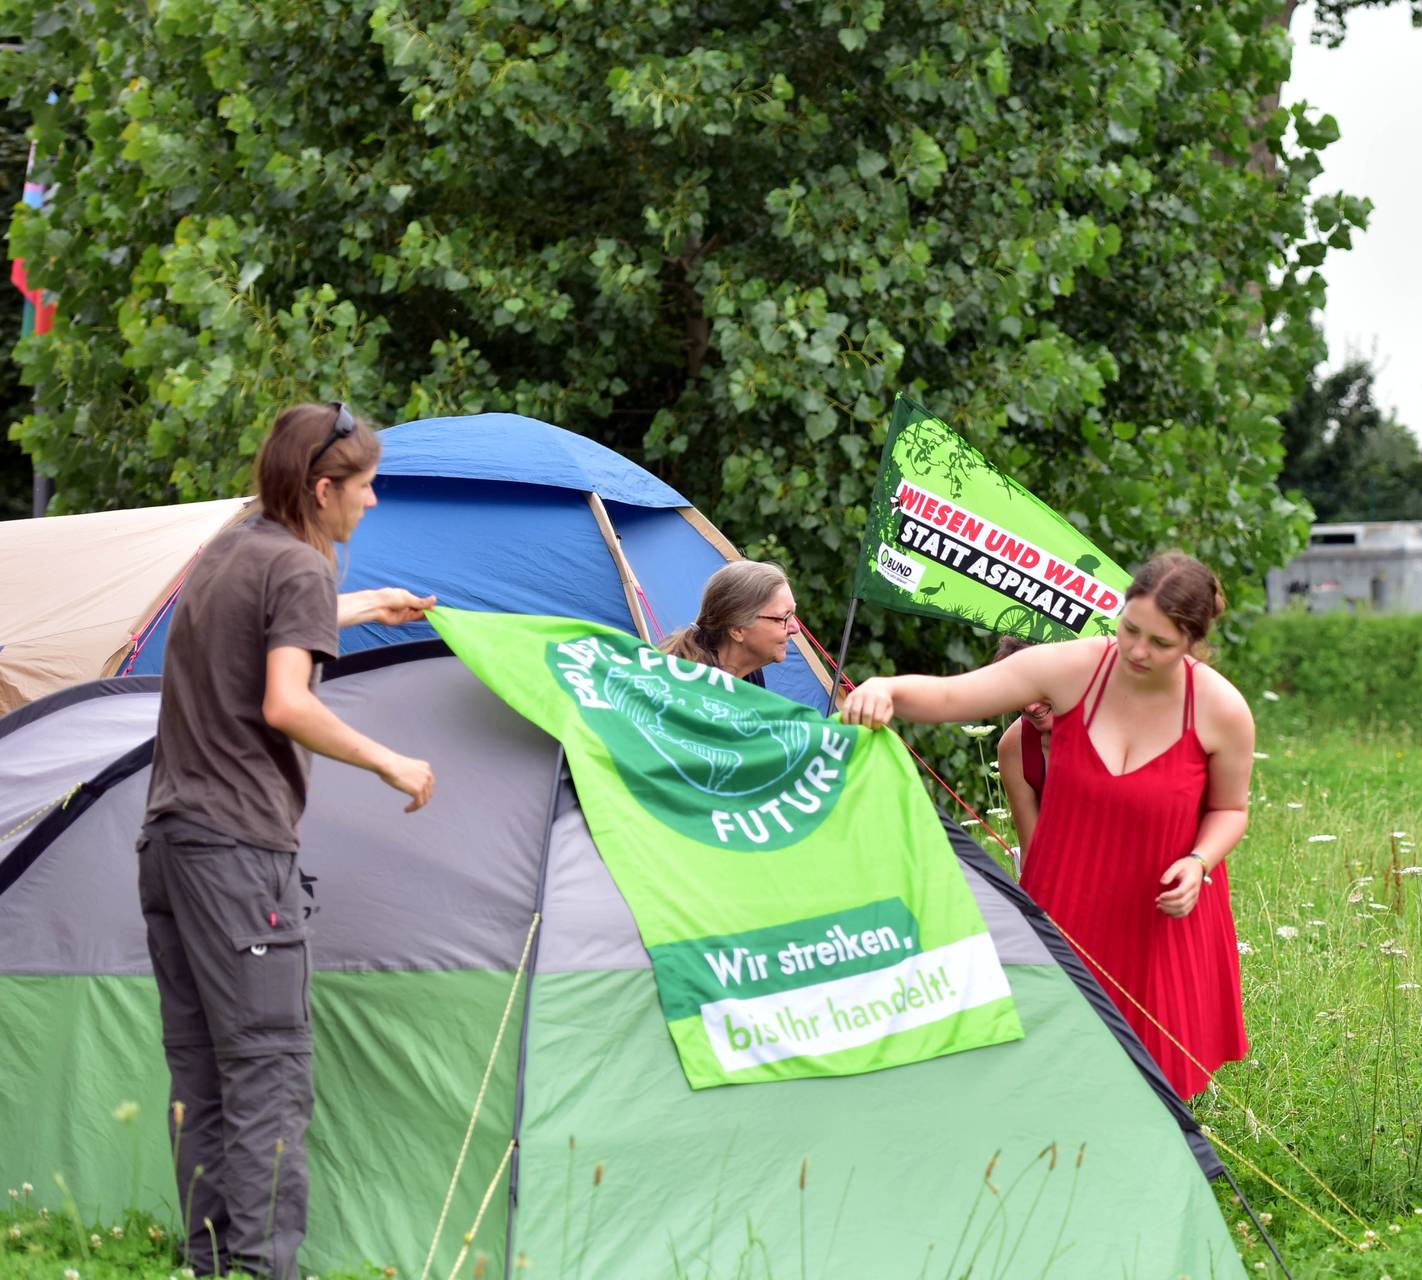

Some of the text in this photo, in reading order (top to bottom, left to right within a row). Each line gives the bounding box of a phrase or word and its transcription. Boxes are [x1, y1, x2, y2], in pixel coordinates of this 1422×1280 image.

[887, 557, 912, 577] BUND
[899, 485, 1119, 611] WIESEN UND WALD
[900, 520, 1086, 627] STATT ASPHALT
[711, 726, 850, 843] FUTURE
[704, 924, 913, 988] Wir streiken,
[724, 1013, 779, 1052] bis
[826, 965, 957, 1033] handelt!
